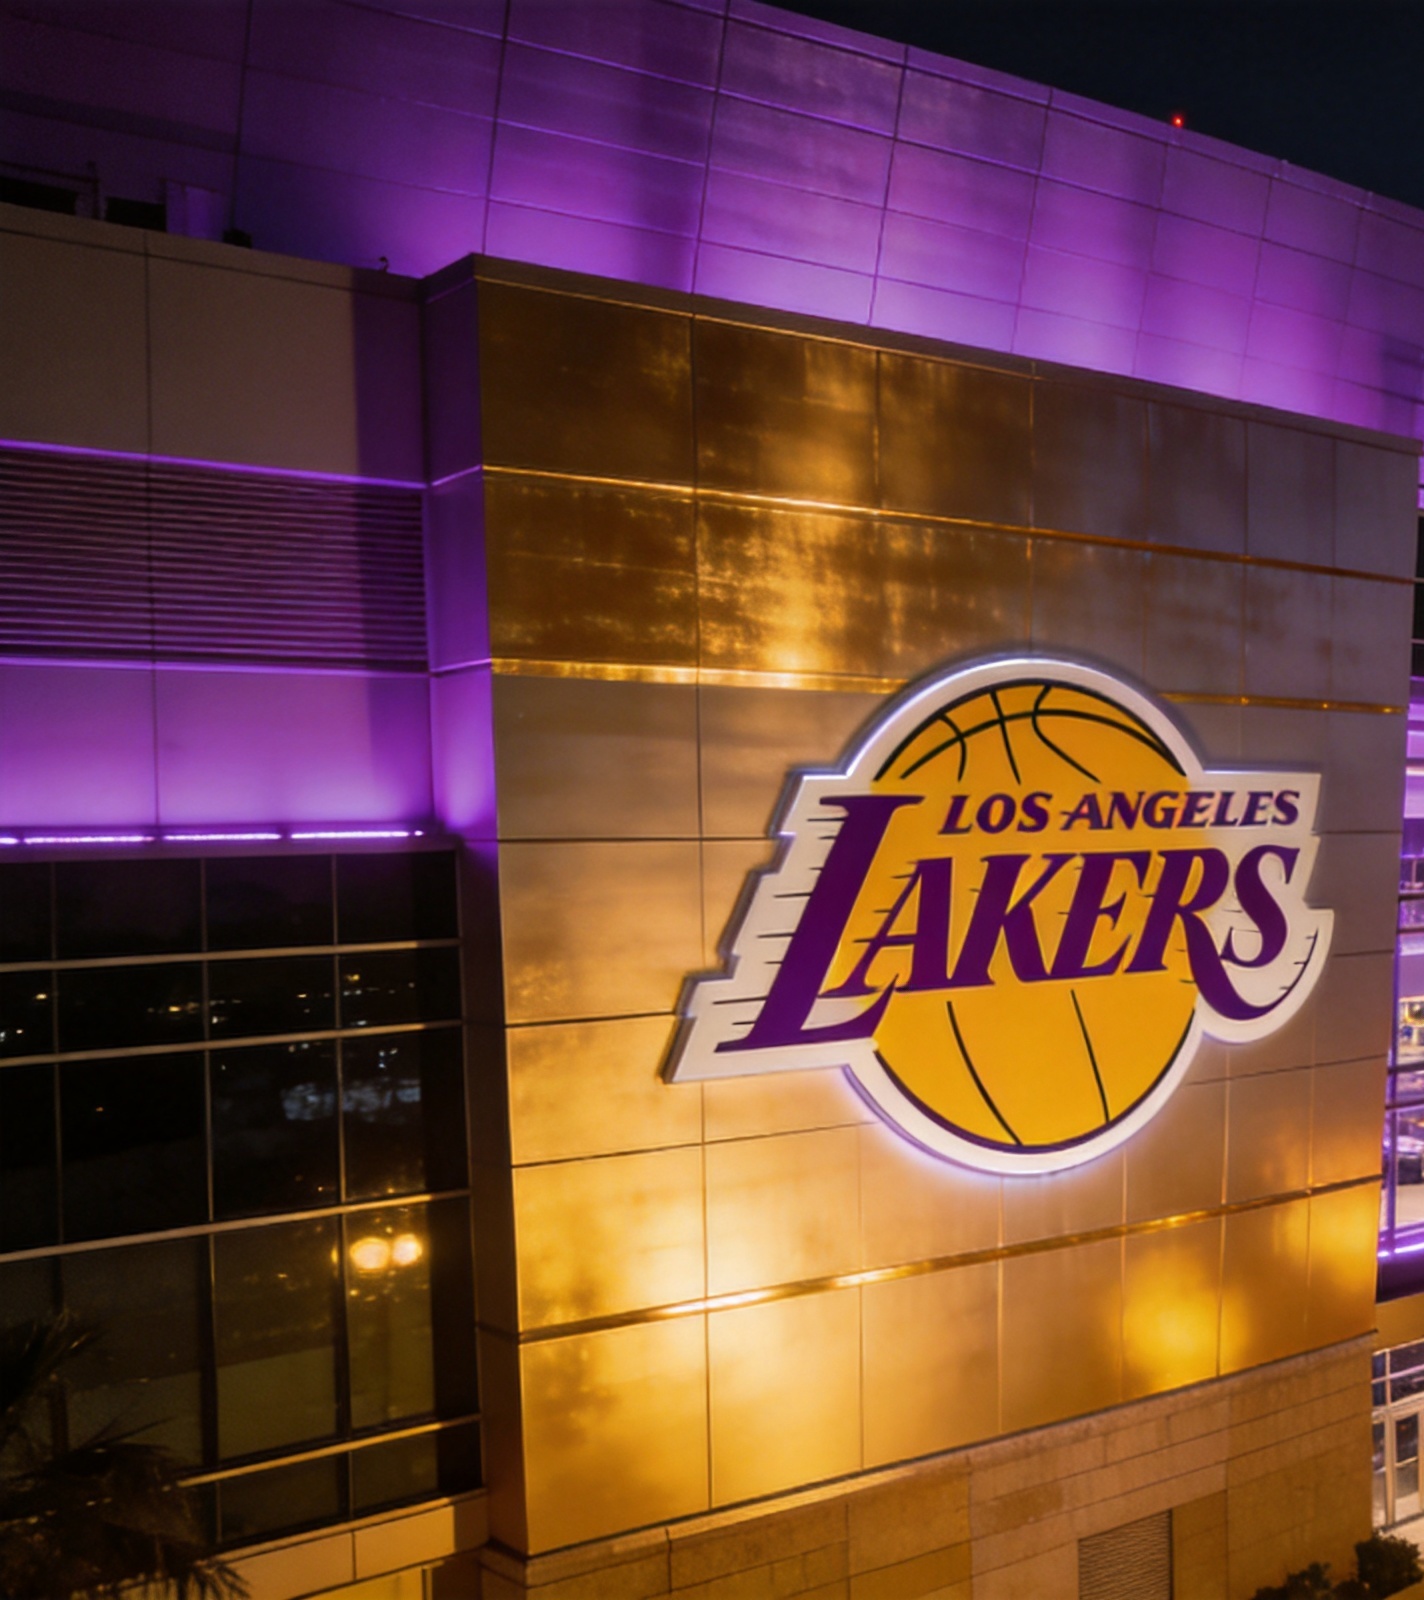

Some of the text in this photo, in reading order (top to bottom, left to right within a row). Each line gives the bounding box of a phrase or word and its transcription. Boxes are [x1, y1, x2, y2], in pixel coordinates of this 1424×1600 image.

[938, 789, 1301, 835] LOS ANGELES
[714, 795, 1316, 1053] LAKERS
